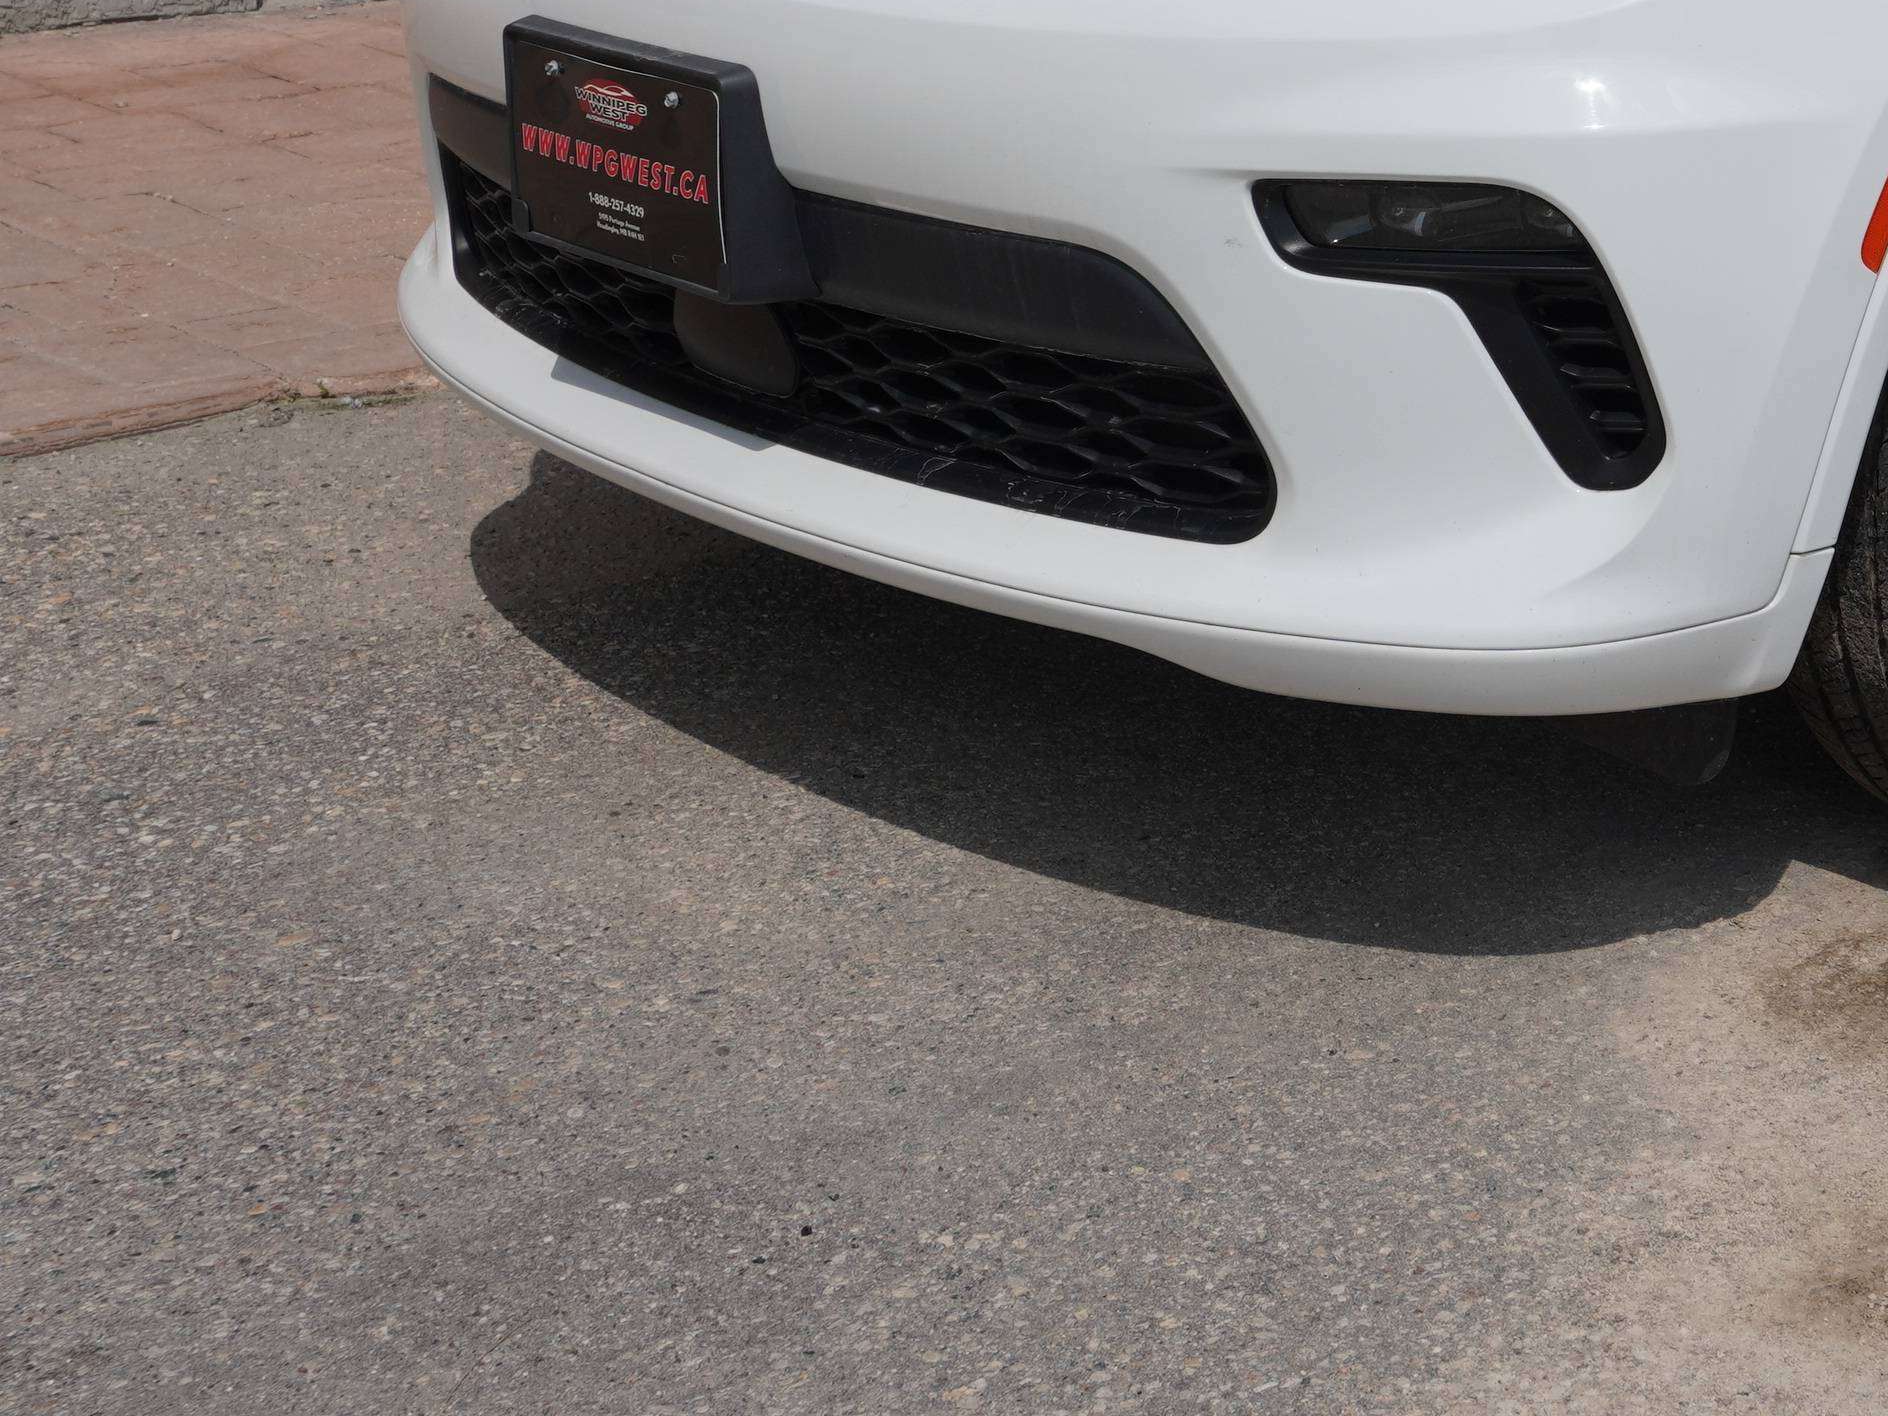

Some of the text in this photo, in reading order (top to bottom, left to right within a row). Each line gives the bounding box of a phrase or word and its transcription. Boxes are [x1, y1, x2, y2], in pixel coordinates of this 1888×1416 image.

[574, 86, 648, 117] WINNIPEG
[588, 102, 630, 122] WEST
[521, 123, 710, 205] WWW.WPGWEST.CA
[589, 191, 645, 218] 1-888-257-4329
